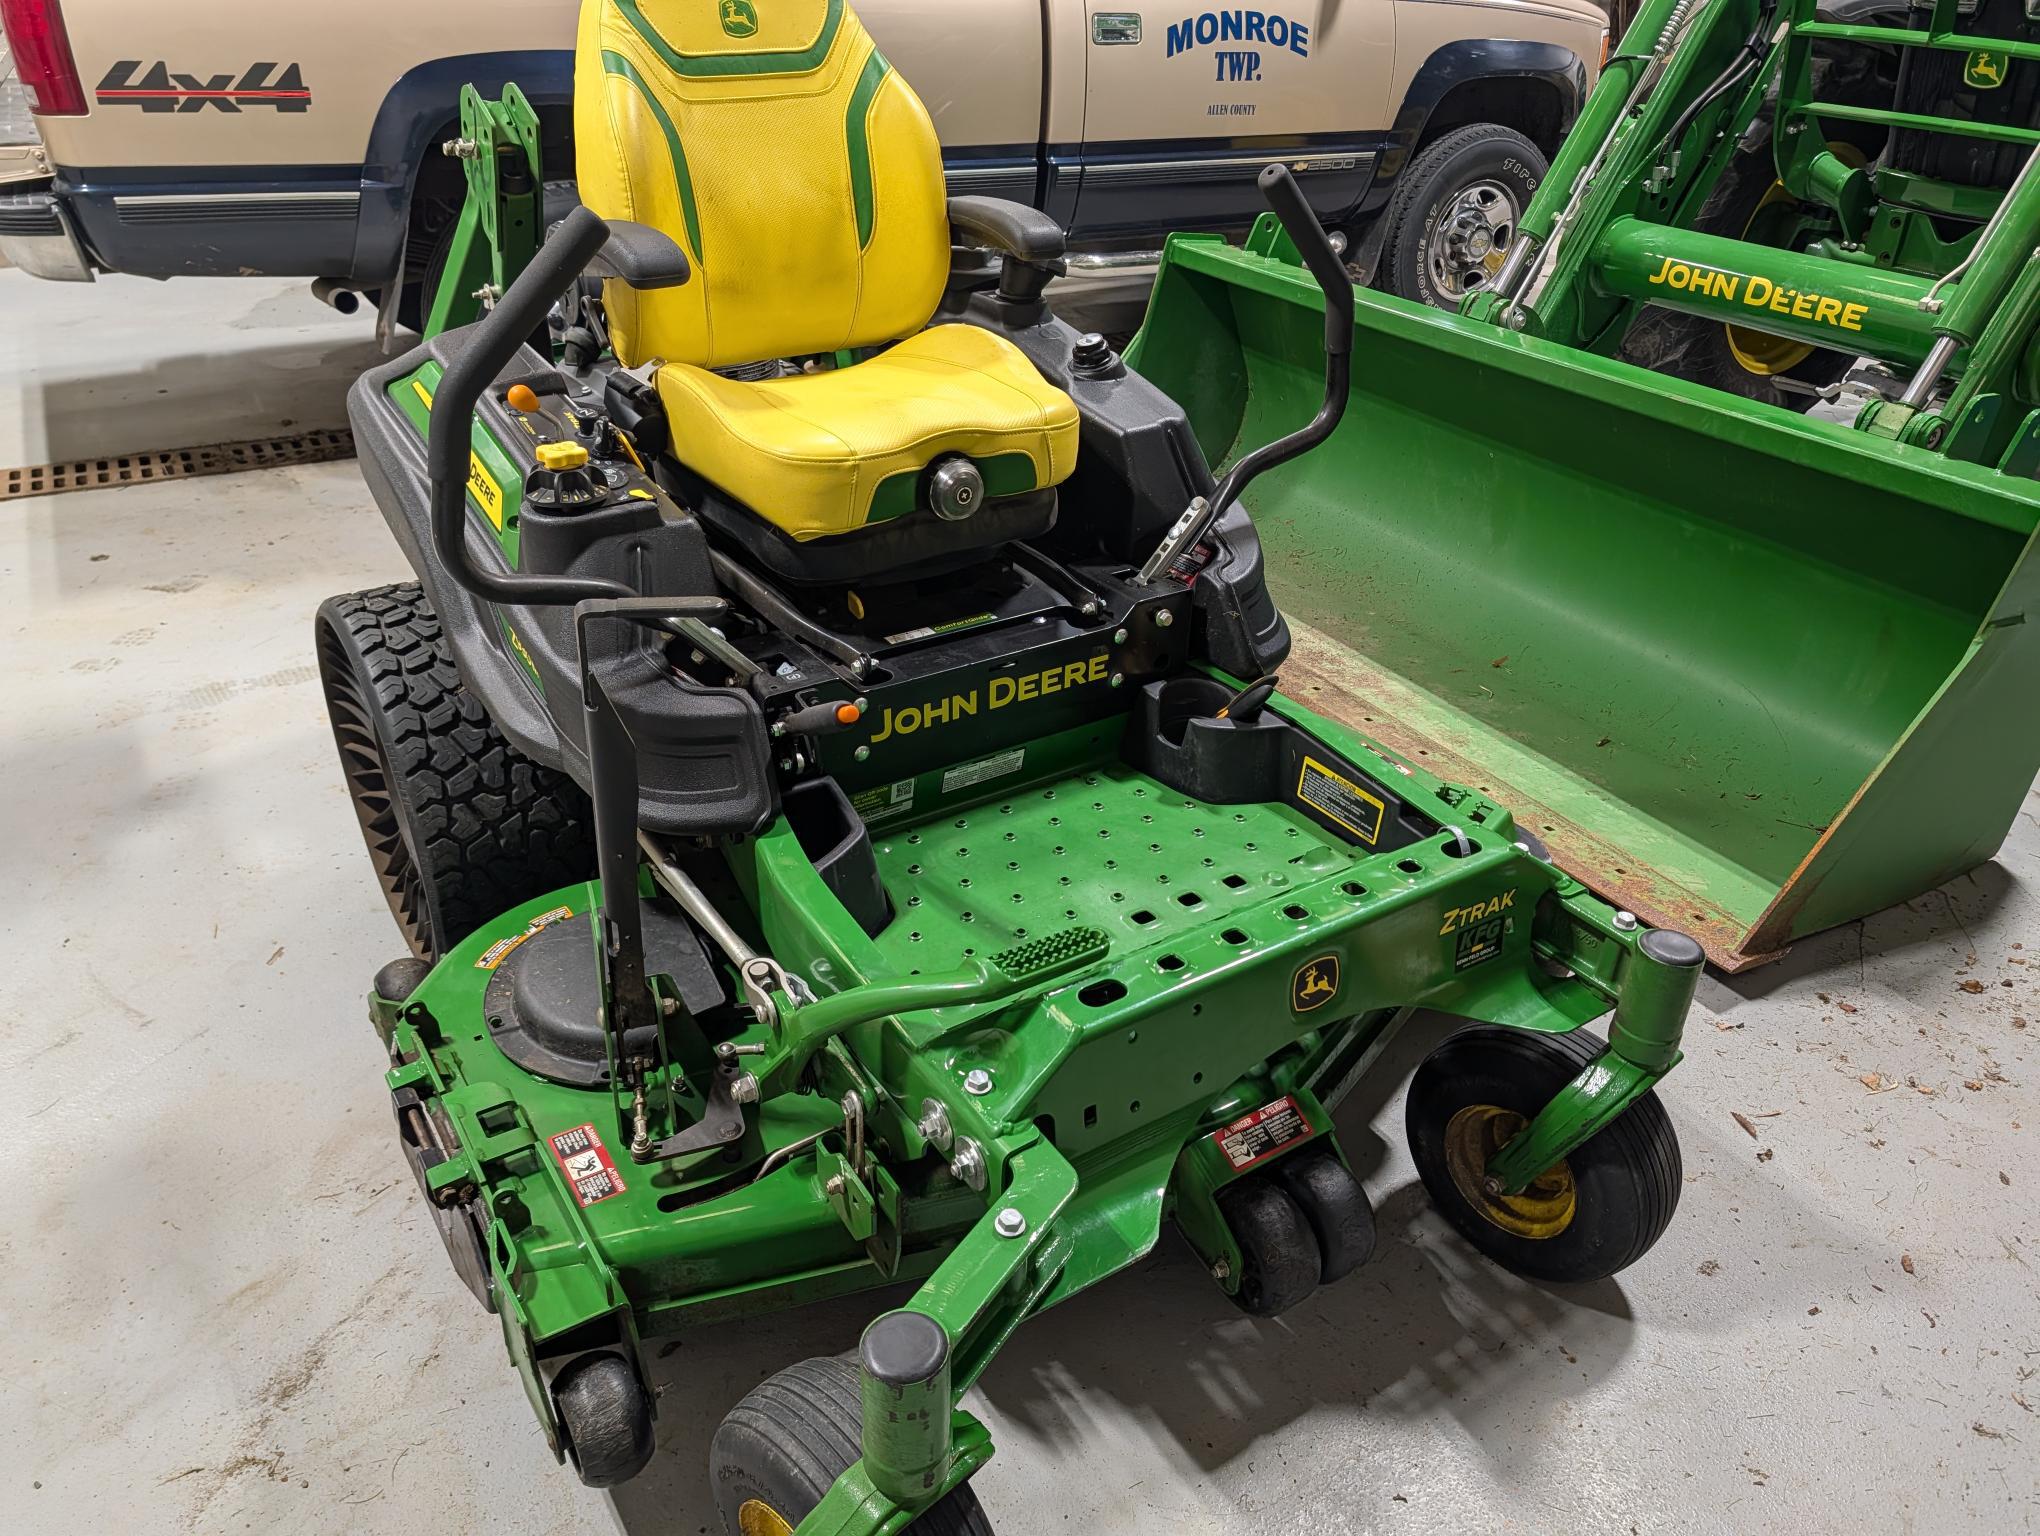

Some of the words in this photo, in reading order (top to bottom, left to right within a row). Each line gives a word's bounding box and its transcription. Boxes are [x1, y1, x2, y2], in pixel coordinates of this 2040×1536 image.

[1167, 10, 1308, 58] MONROE
[1215, 51, 1262, 81] TWP.
[95, 61, 312, 112] 4x4
[1207, 104, 1228, 115] ALLEN
[1230, 104, 1256, 115] COUNTY
[1308, 160, 1355, 170] 2500
[1503, 157, 1537, 197] Fire
[1425, 203, 1437, 232] AT
[1649, 257, 1740, 300] JOHN
[1743, 276, 1868, 331] DEERE
[470, 463, 496, 506] DEERE
[871, 690, 977, 743] JOHN
[989, 654, 1110, 710] DEERE
[1440, 888, 1517, 936] ZTRAK
[1265, 1100, 1289, 1116] PELIGRO
[586, 1128, 602, 1148] DANGER
[1230, 1117, 1254, 1133] DANGER
[611, 1169, 626, 1192] PELIGRO
